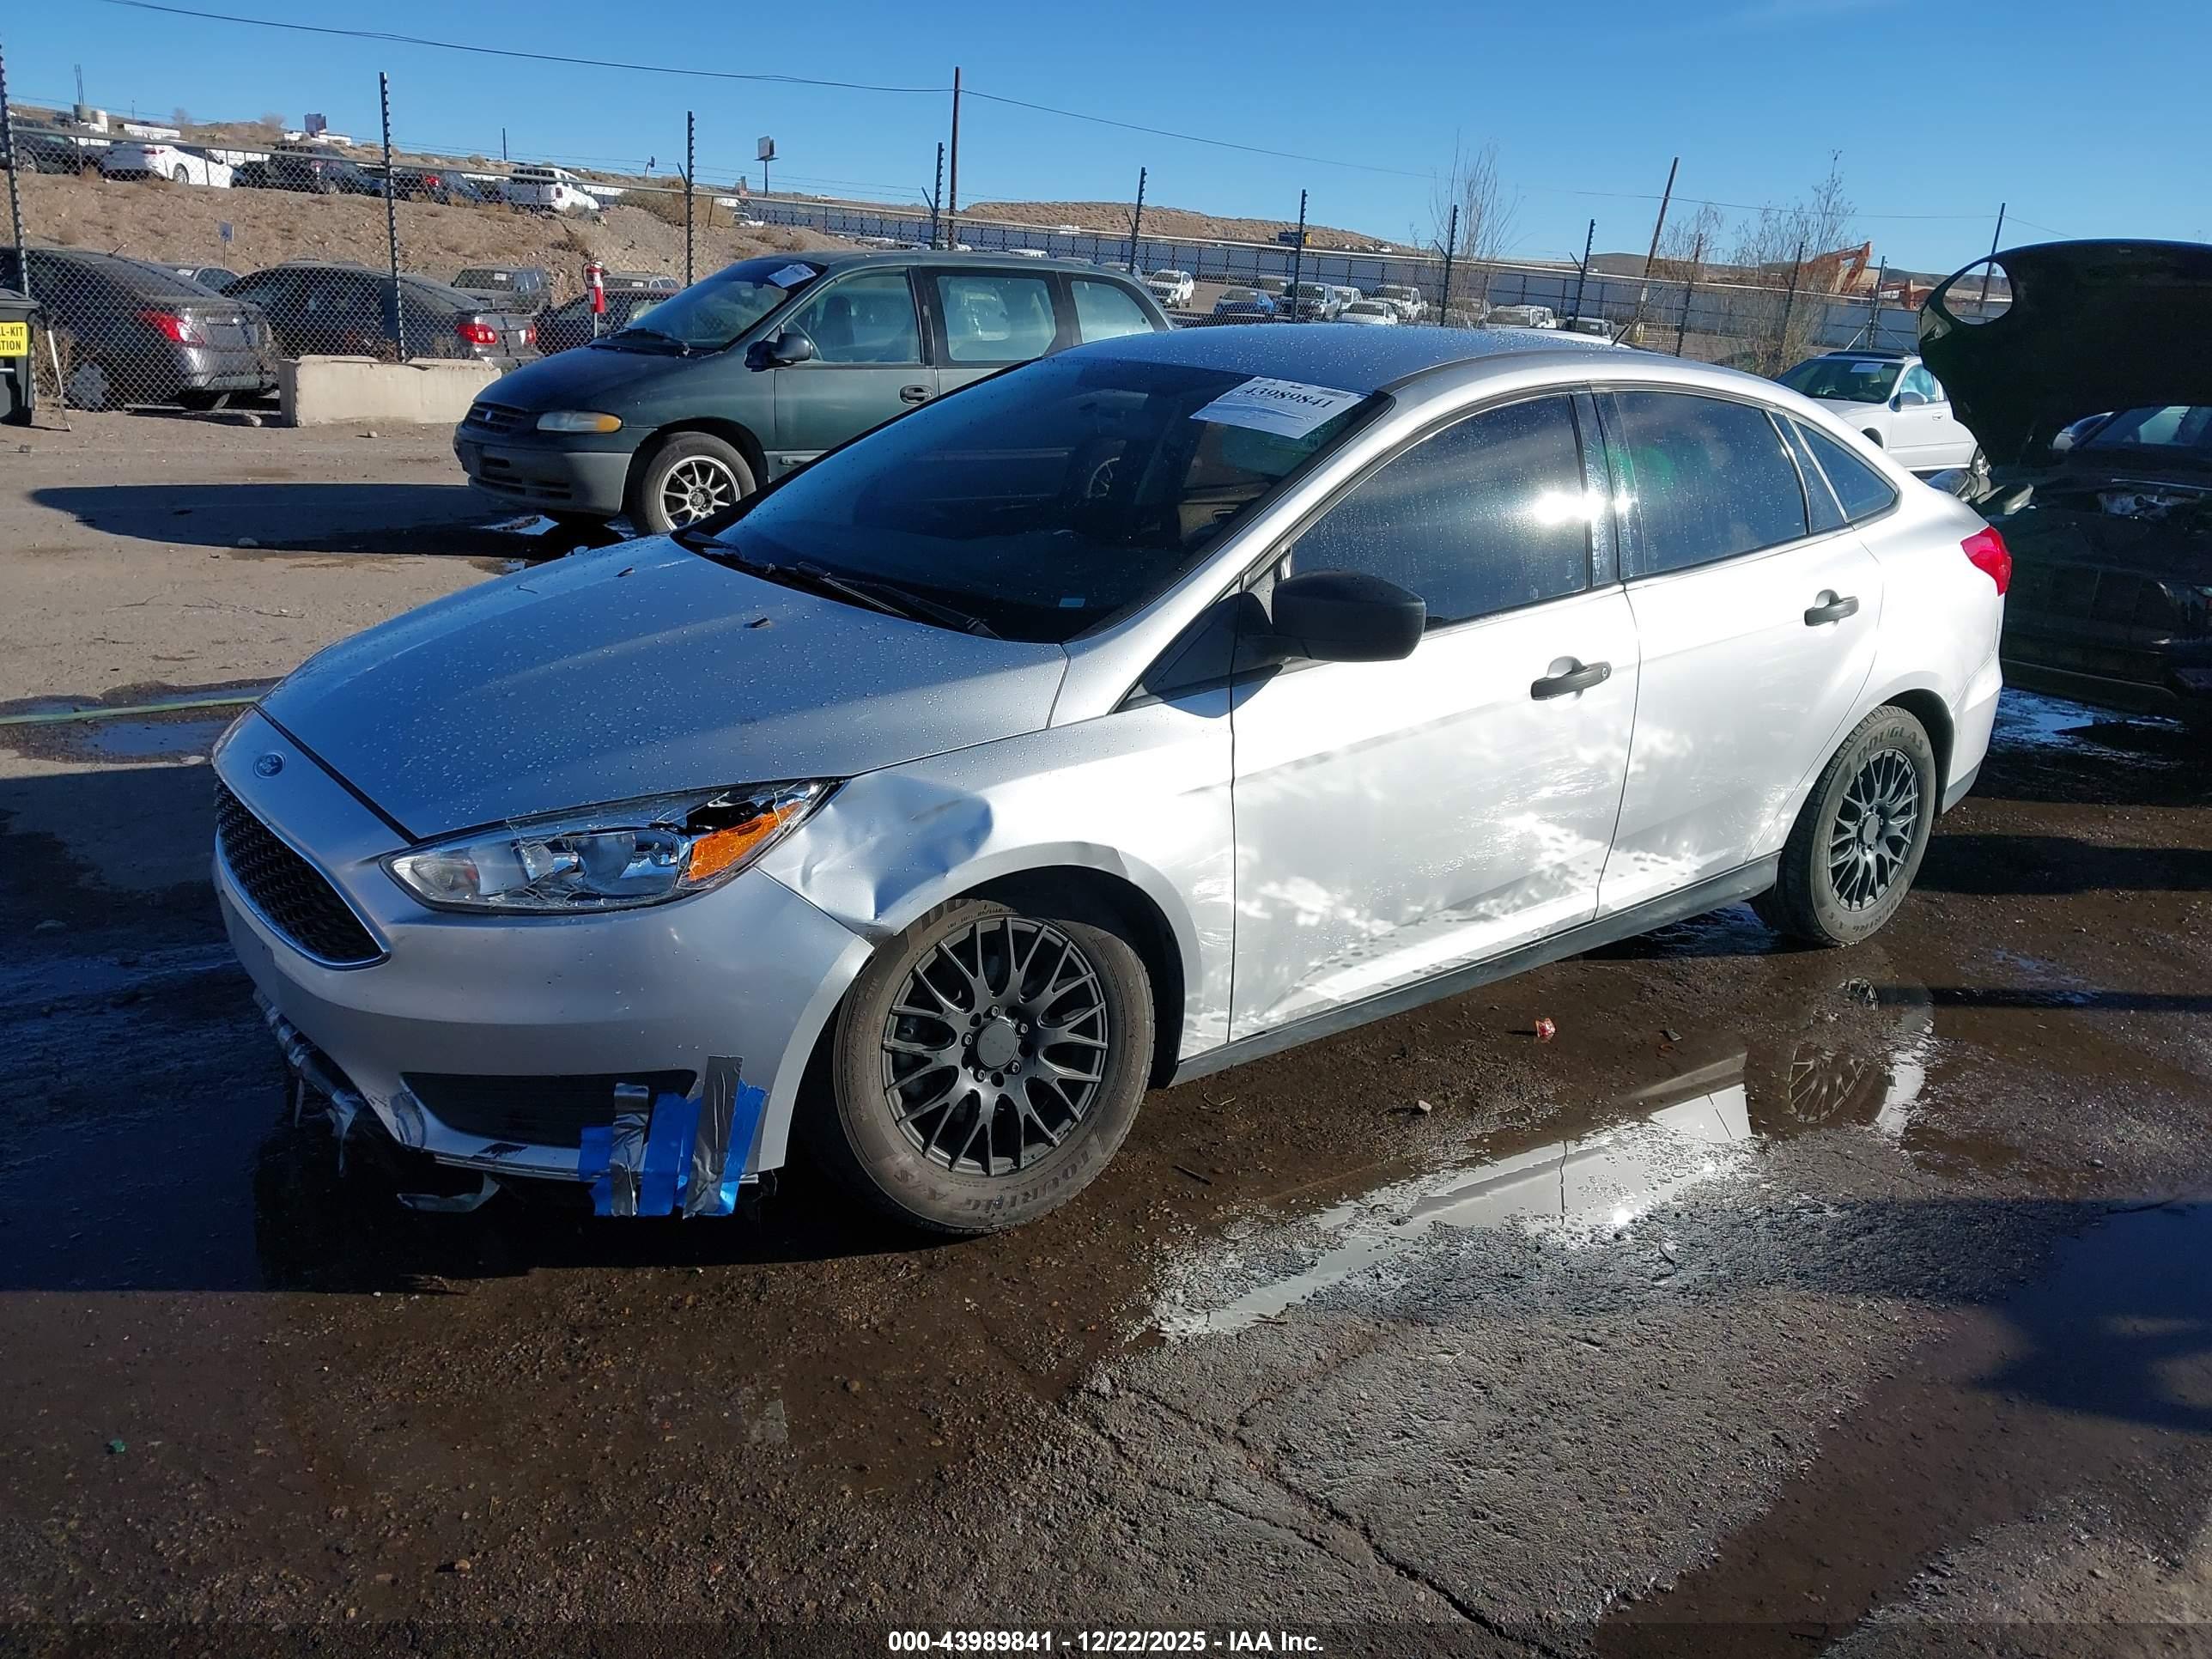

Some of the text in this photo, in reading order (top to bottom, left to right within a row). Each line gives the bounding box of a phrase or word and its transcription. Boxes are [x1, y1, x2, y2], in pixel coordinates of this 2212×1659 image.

[0, 326, 23, 337] L-KIT
[1243, 386, 1335, 408] 43989841
[1857, 726, 1923, 764] DOUGLAS
[963, 1150, 1091, 1211] TOURING
